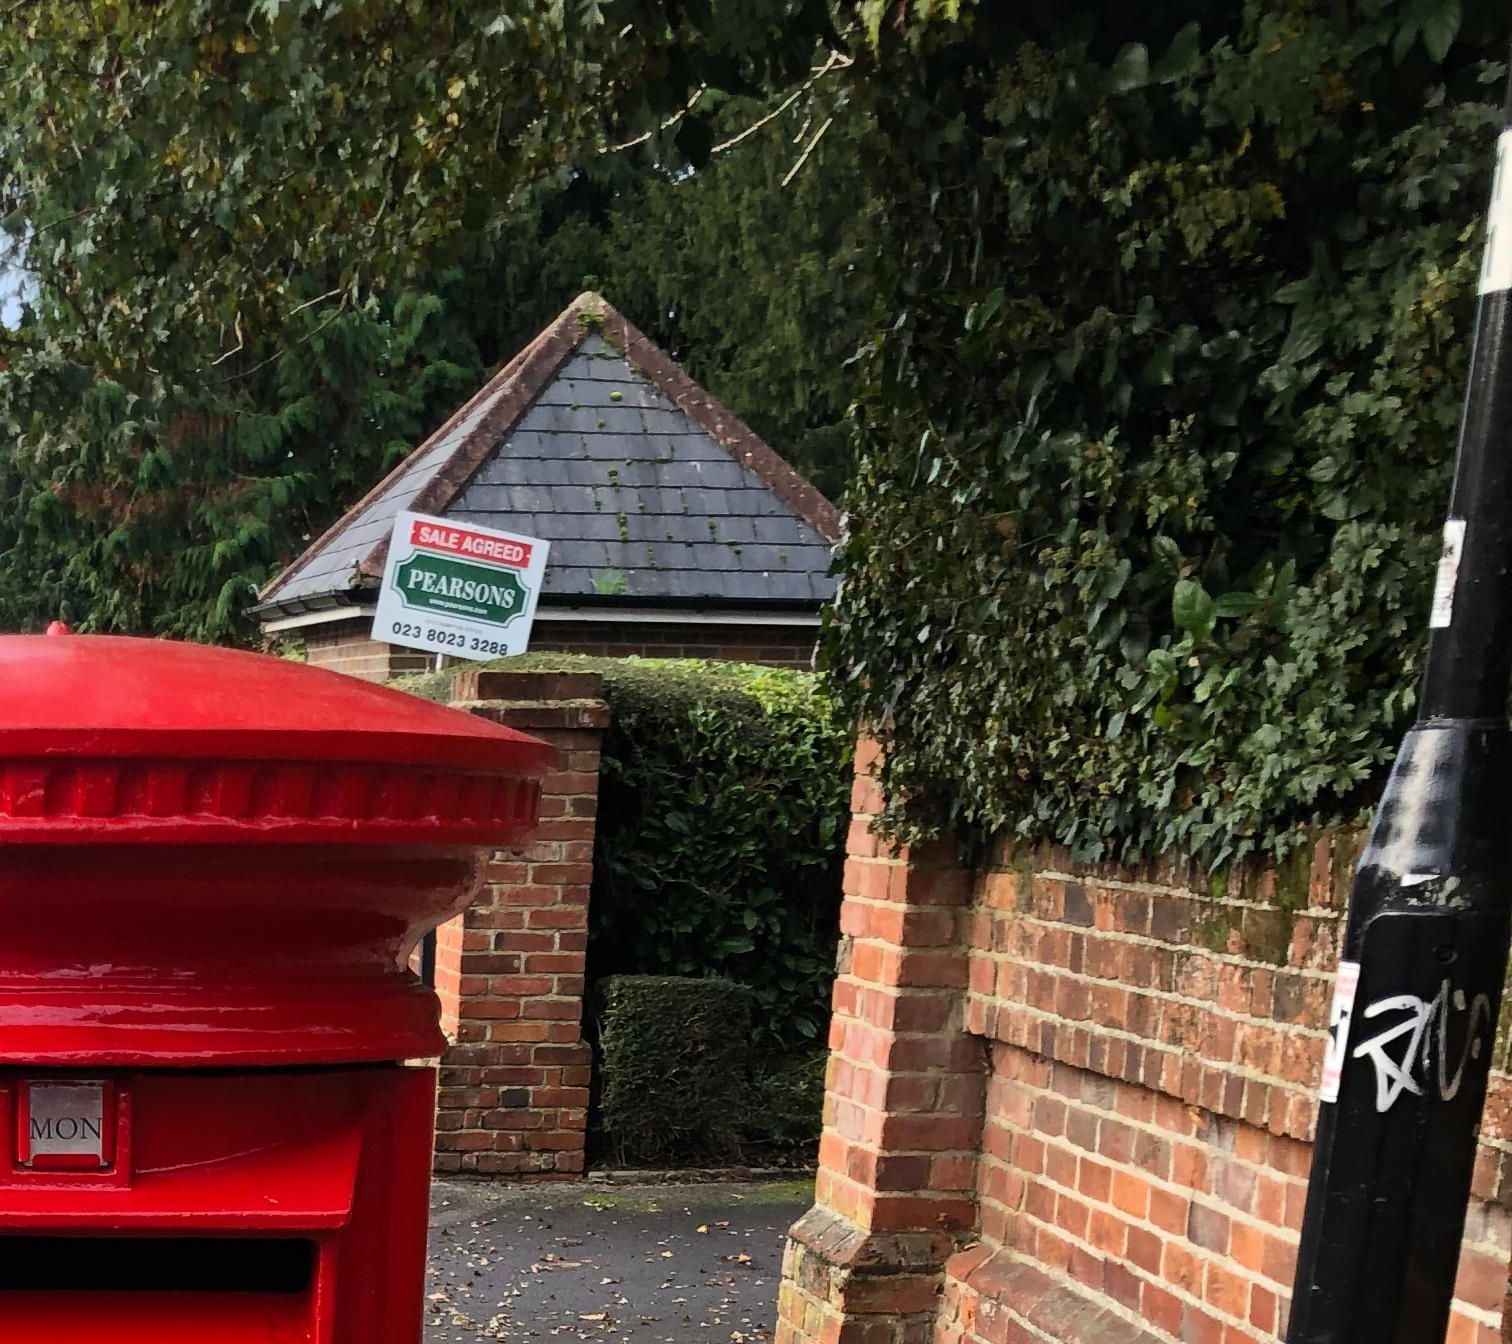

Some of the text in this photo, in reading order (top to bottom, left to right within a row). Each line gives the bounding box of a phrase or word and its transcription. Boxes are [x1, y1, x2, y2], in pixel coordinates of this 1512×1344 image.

[418, 526, 524, 563] SALE AGREED
[407, 568, 516, 610] PEARSONS
[392, 621, 422, 639] 023
[426, 628, 466, 648] 8023
[470, 637, 508, 657] 3288
[29, 1117, 104, 1141] MON
